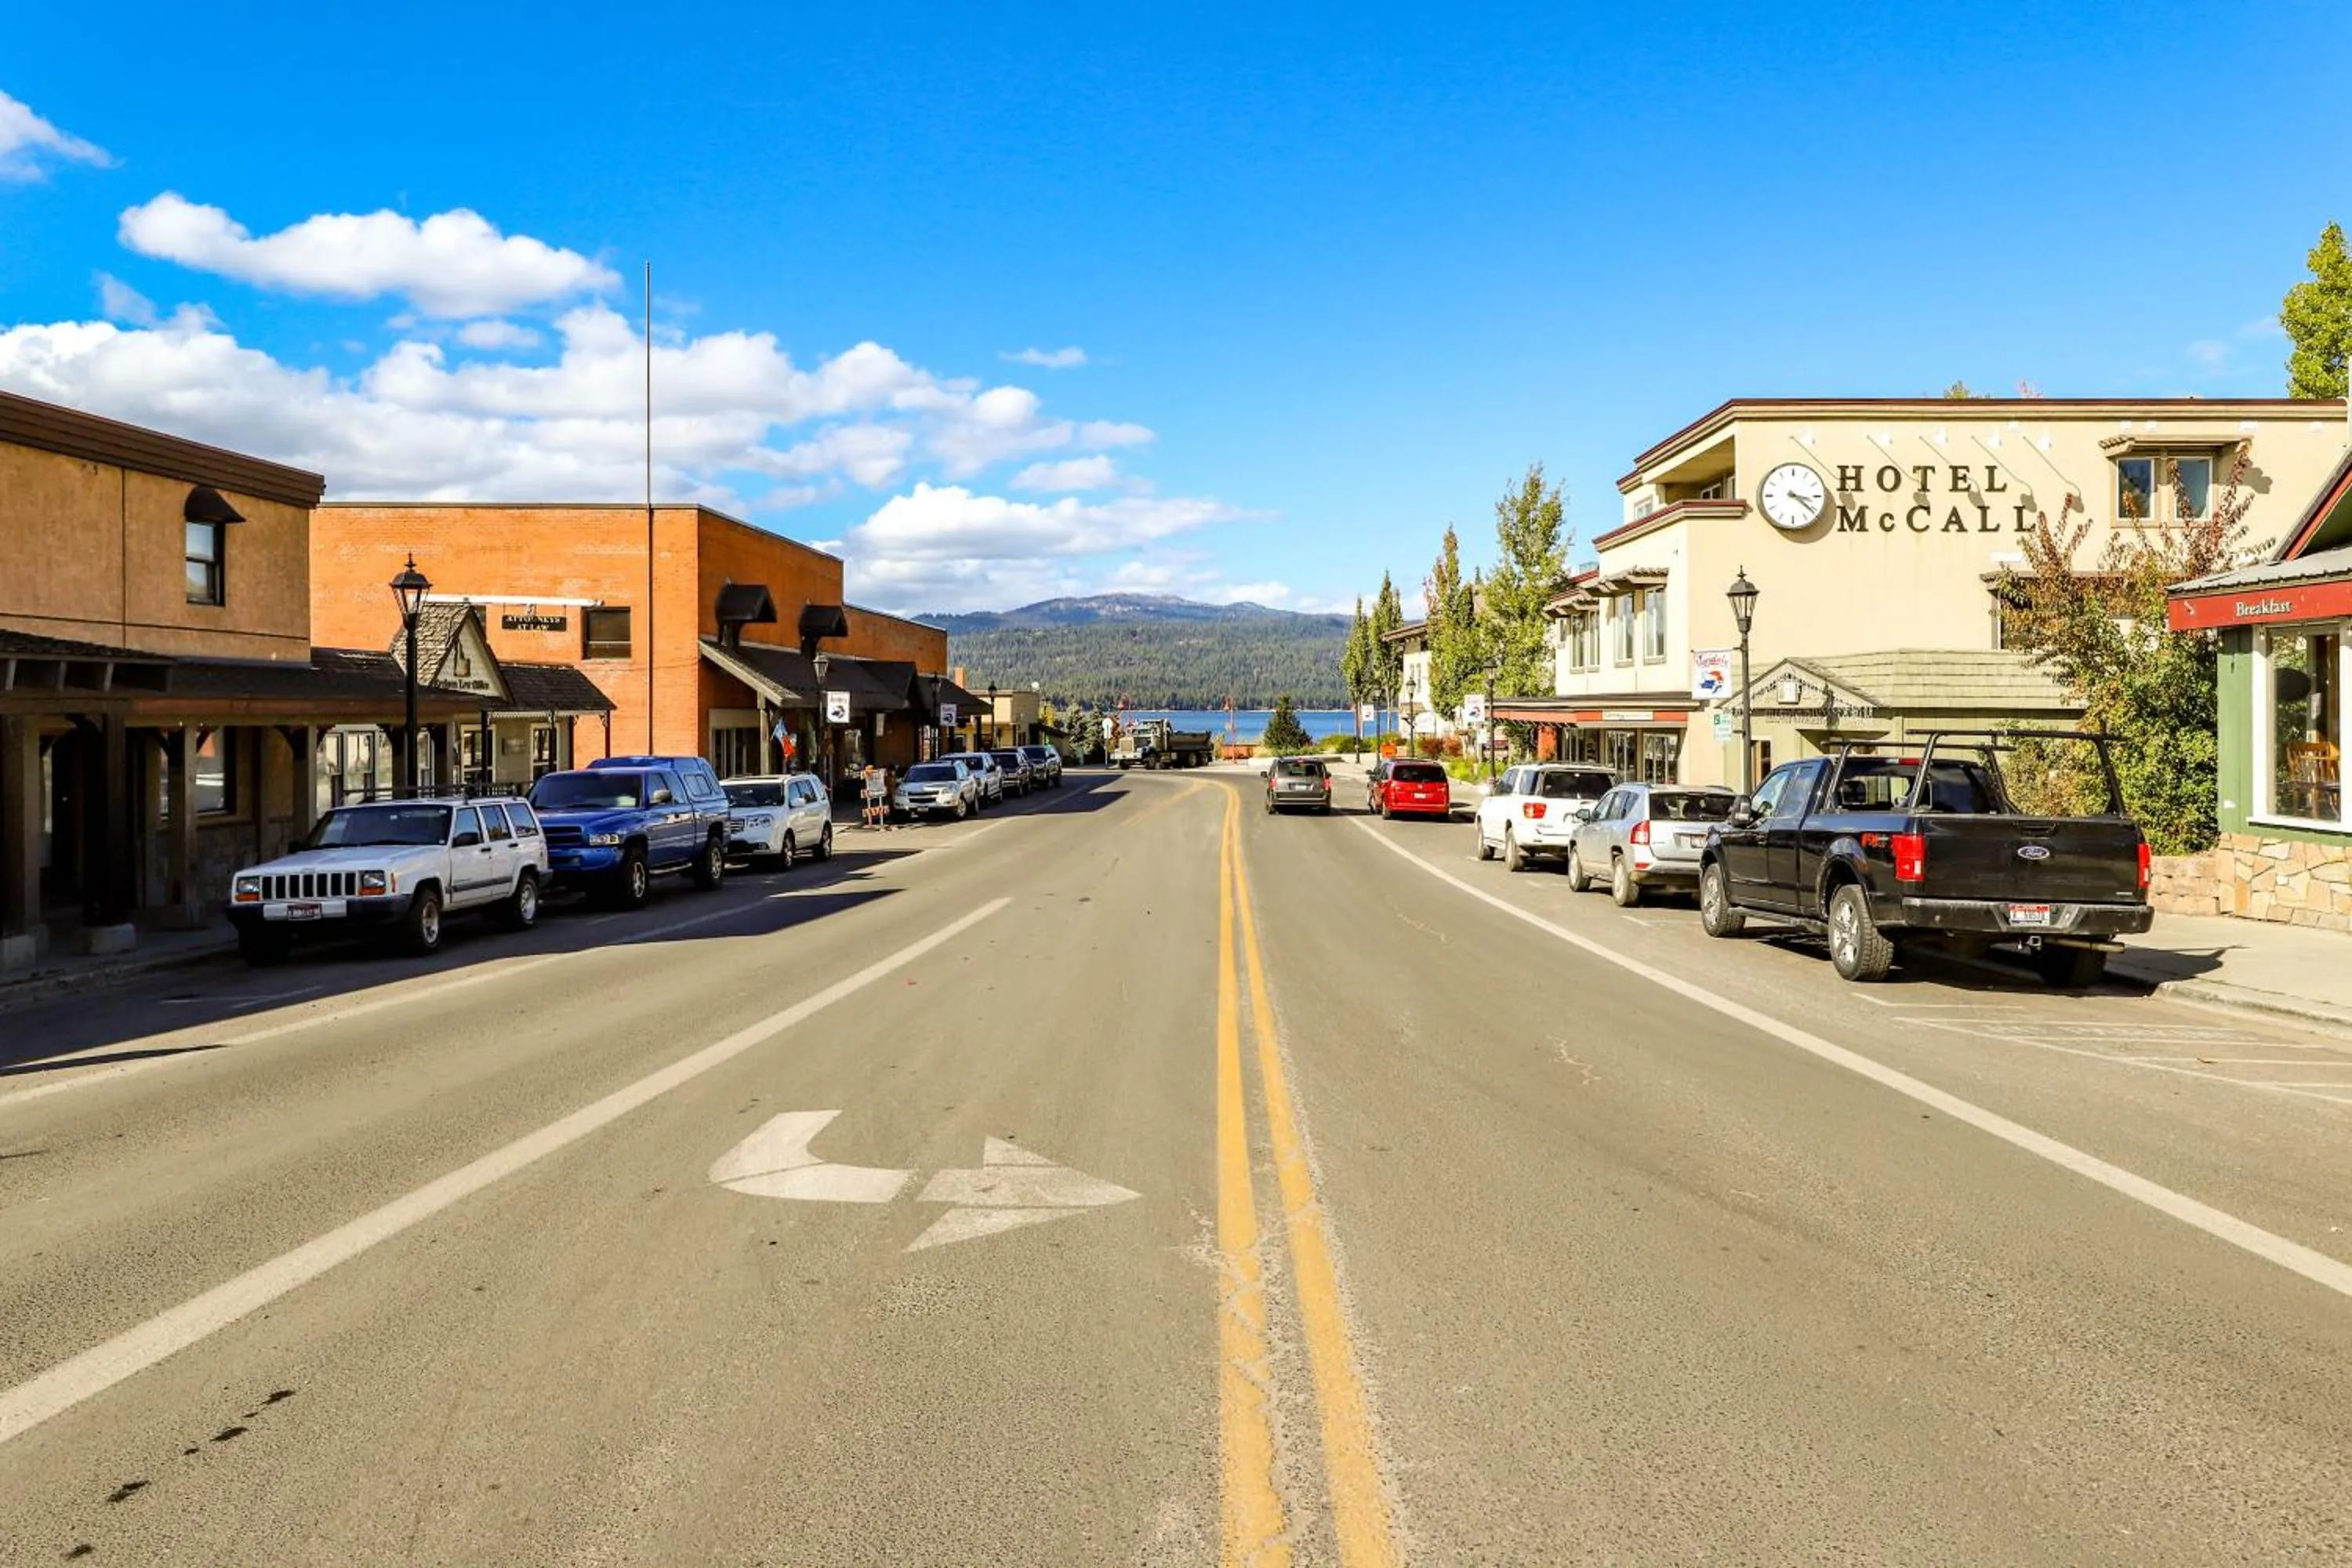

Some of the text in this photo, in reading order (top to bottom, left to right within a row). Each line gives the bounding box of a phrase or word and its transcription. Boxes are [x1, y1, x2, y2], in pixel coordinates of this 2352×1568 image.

[1836, 465, 2008, 492] HOTEL
[1835, 505, 2037, 532] McCALL
[2235, 597, 2292, 616] Breakfast
[506, 615, 561, 623] ATTONEYS
